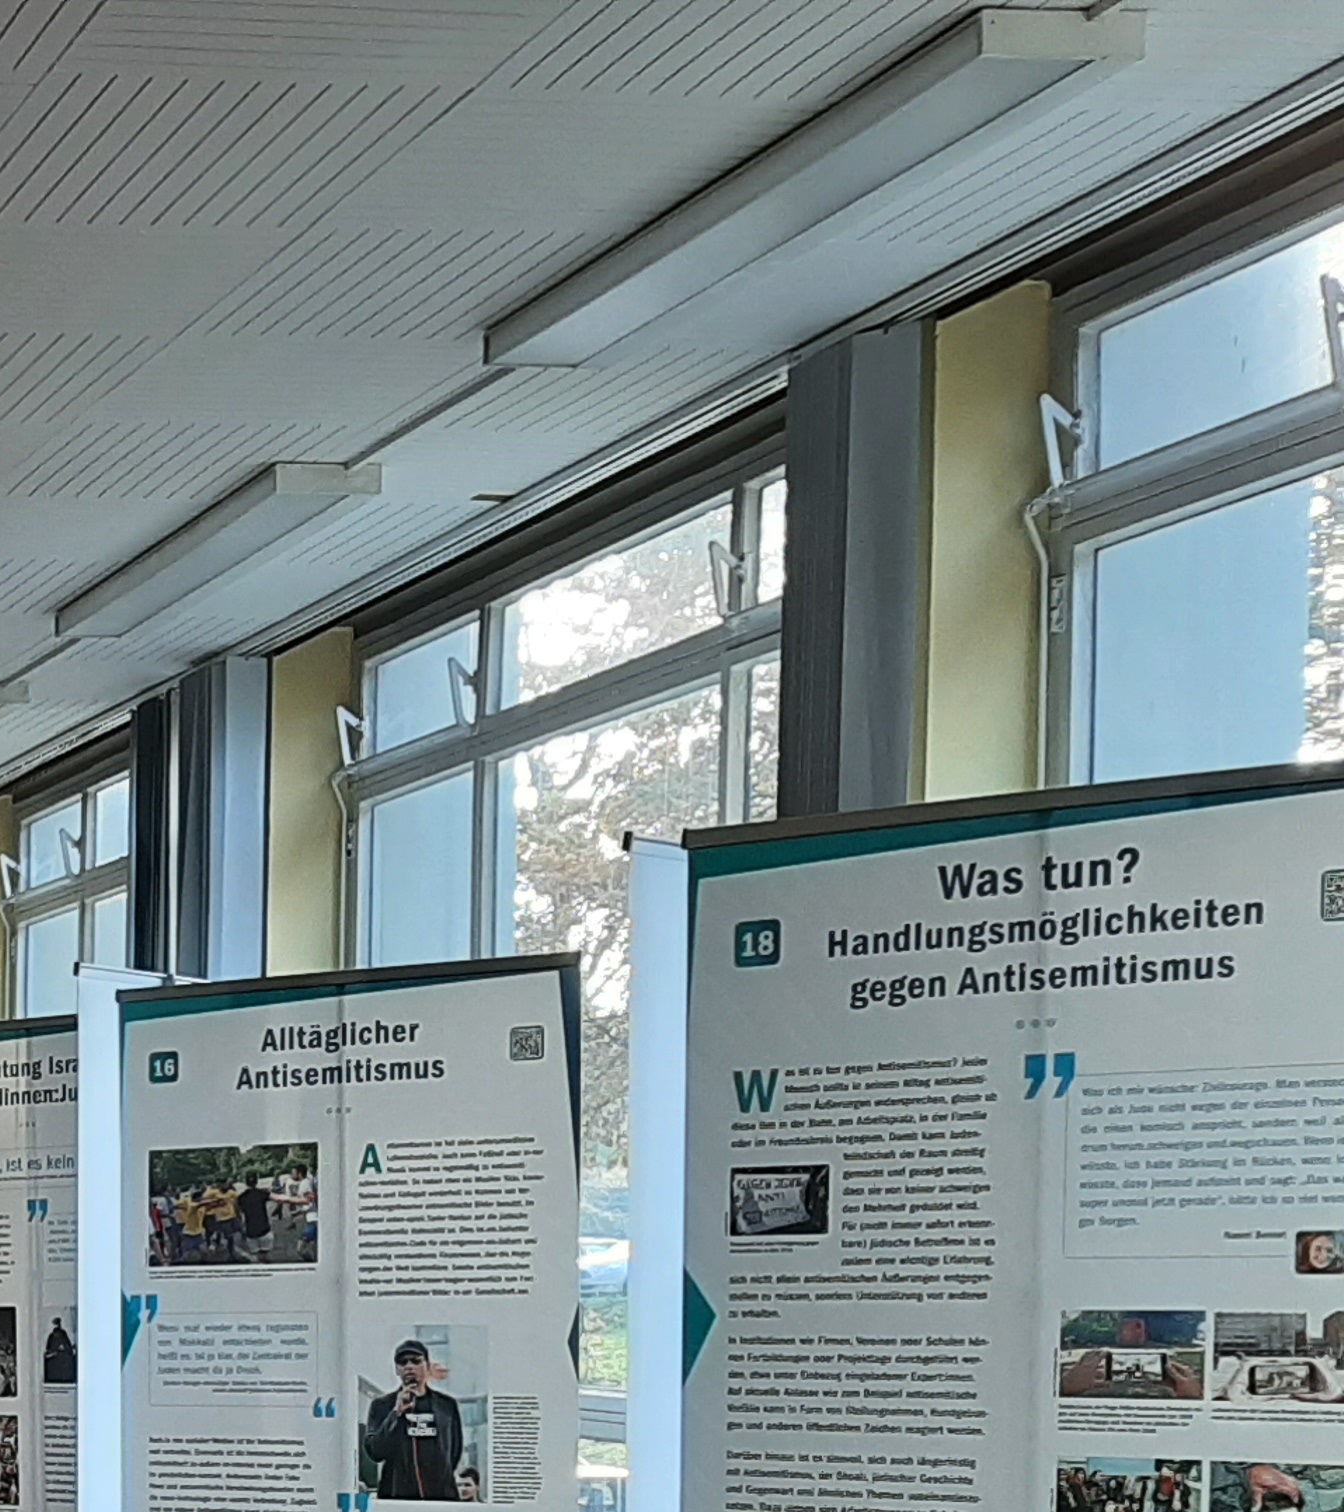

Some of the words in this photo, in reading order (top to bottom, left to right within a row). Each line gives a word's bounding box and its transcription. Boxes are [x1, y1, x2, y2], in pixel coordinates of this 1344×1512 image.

[937, 862, 1024, 901] Was
[1040, 847, 1142, 891] tun?
[740, 930, 776, 957] 18
[826, 899, 1265, 959] Handlungsmöglichkeiten
[848, 972, 946, 1009] gegen
[956, 953, 1236, 997] Antisemitismus
[260, 1020, 420, 1053] Alltäglicher
[152, 1058, 176, 1078] 16
[235, 1056, 445, 1091] Antisemitismus
[46, 1154, 75, 1170] kein
[358, 1143, 383, 1175] A
